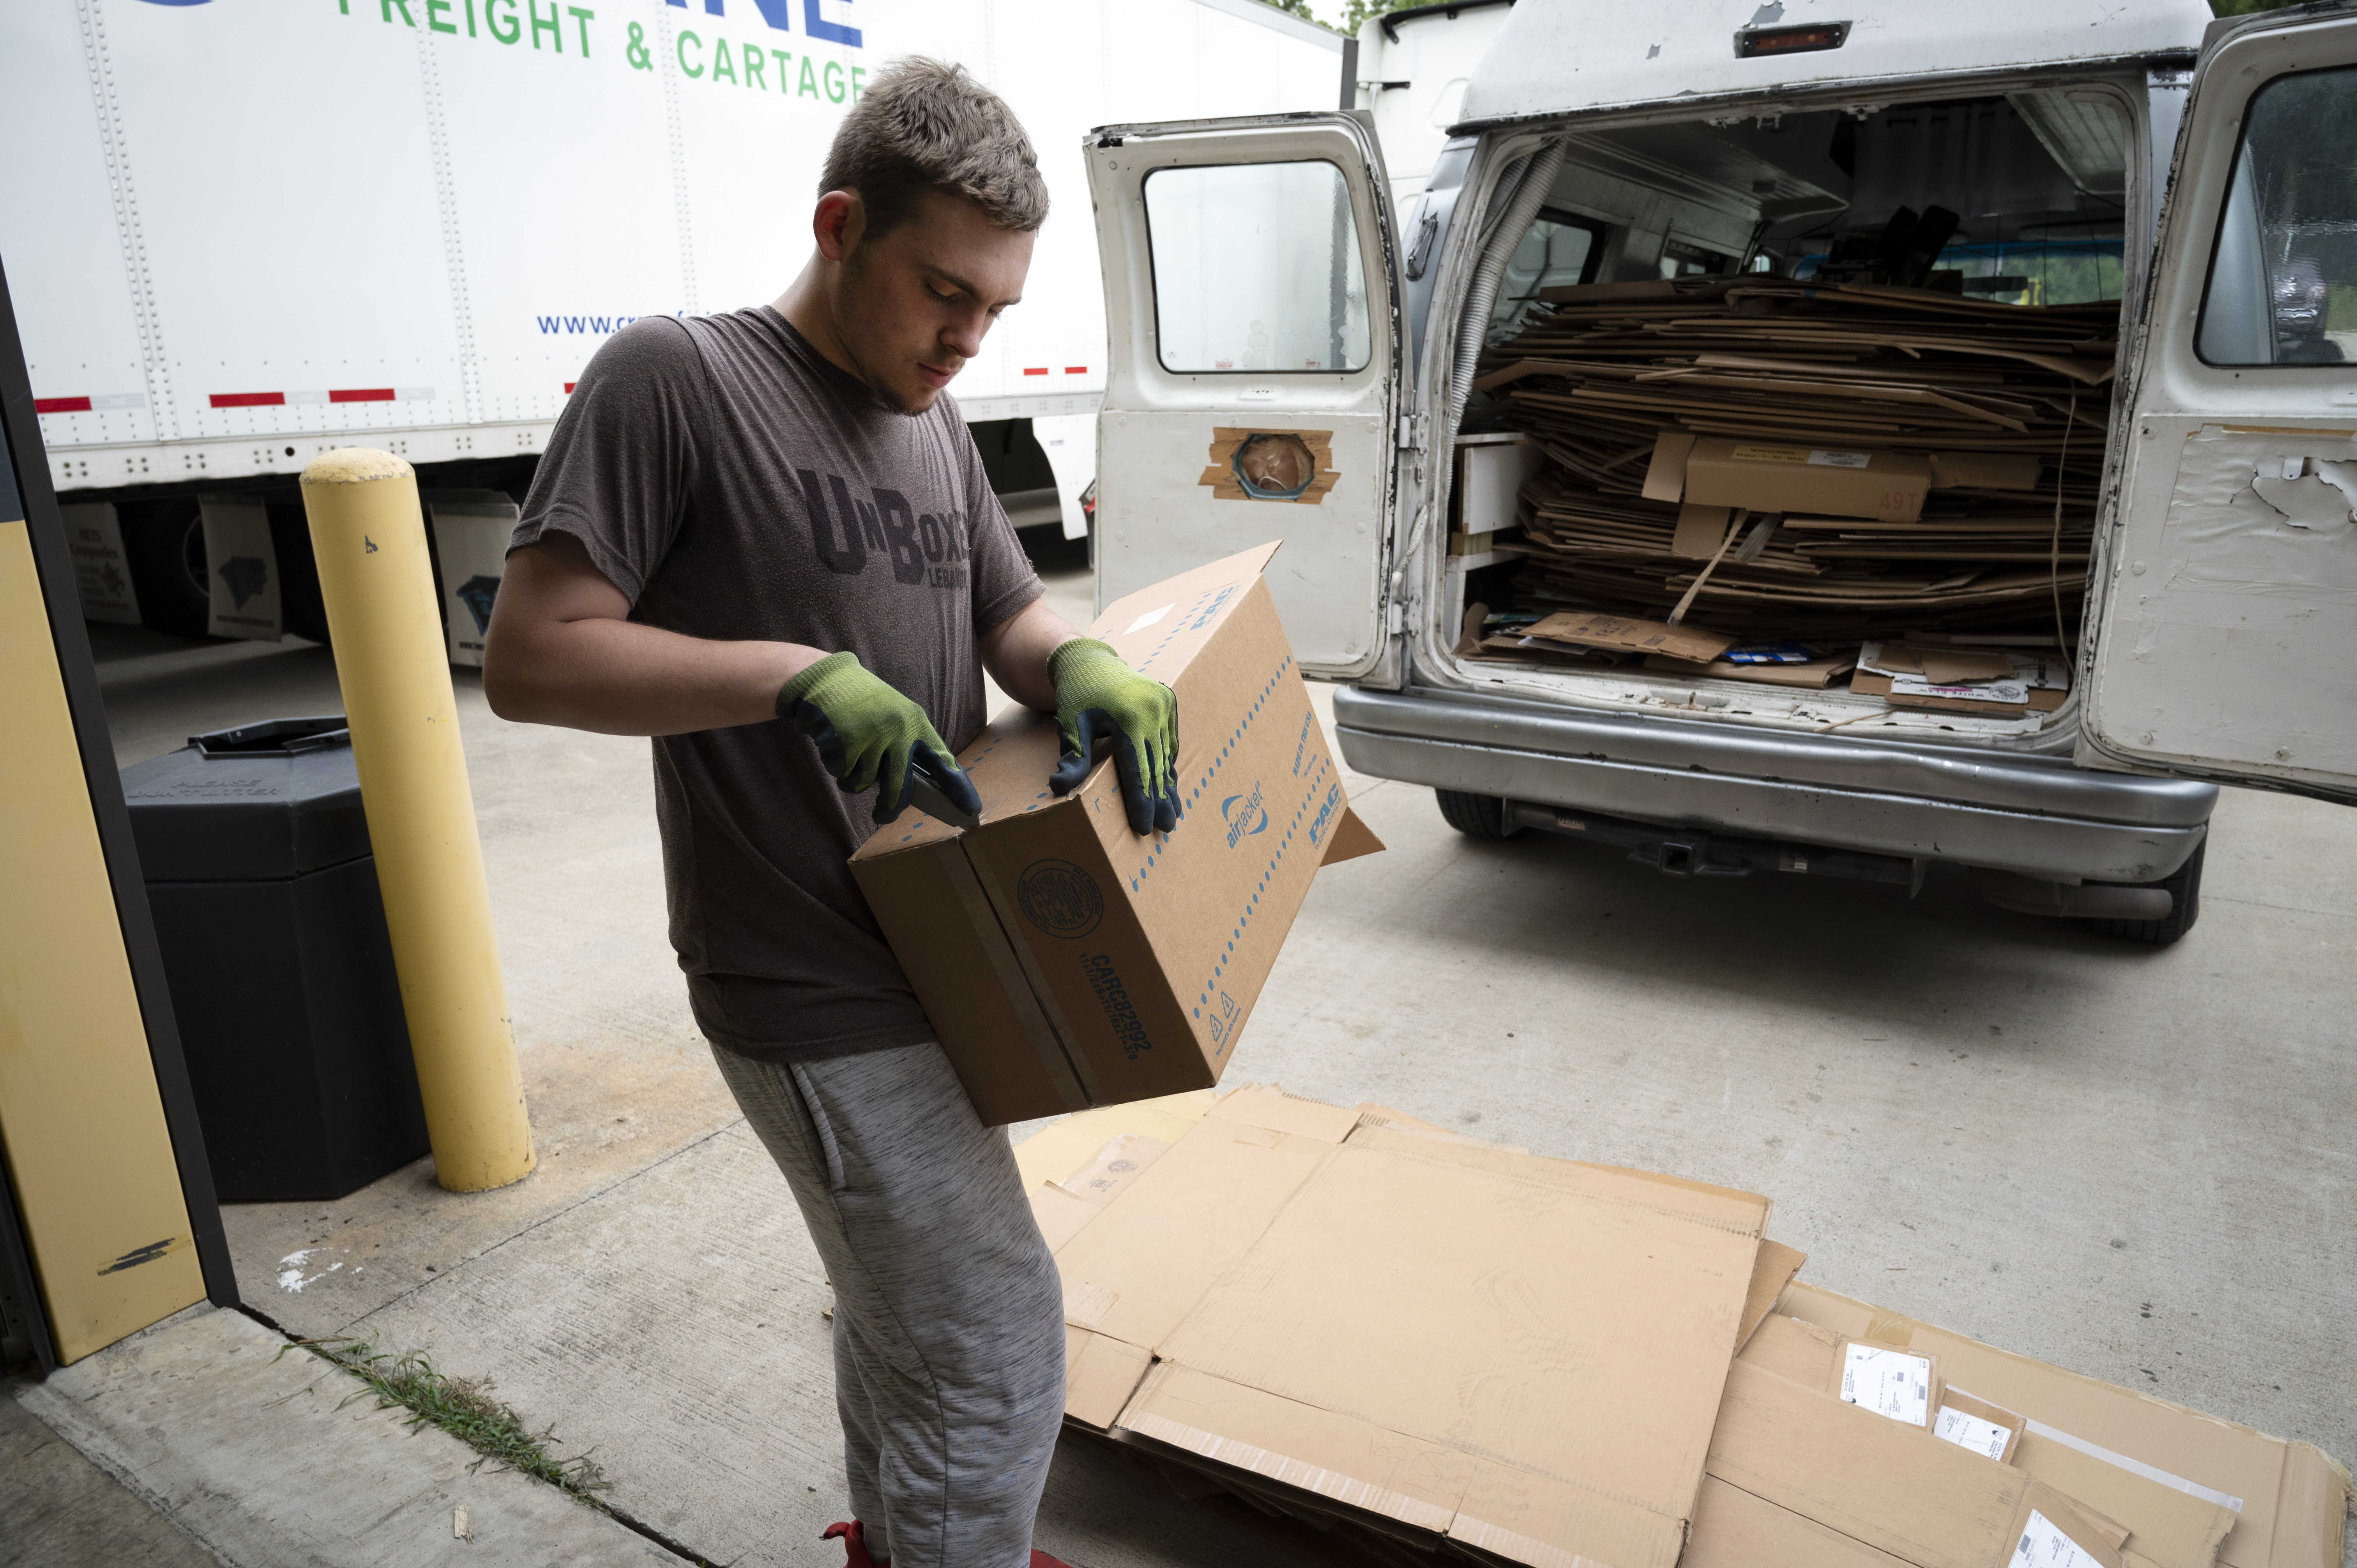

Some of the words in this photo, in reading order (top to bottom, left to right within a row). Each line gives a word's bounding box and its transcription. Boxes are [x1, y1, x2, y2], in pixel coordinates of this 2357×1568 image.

[338, 0, 595, 58] EIGHT
[627, 21, 653, 72] &
[1189, 586, 1234, 631] PAC
[1204, 583, 1242, 626] WORLDWIDE
[1293, 751, 1301, 778] MADE
[1299, 742, 1304, 755] IN
[171, 779, 262, 788] PLEASE
[202, 788, 280, 797] LITTER
[1309, 783, 1339, 845] PAC
[1315, 795, 1342, 850] WORLDWIDE
[1040, 874, 1050, 887] TEST
[1046, 887, 1057, 902] (ECT)
[1052, 887, 1065, 906] CRUSH
[1073, 868, 1085, 879] PAC
[1085, 879, 1101, 916] WORLDWIDE
[1039, 922, 1049, 931] OH
[1091, 955, 1152, 1052] CARC82992
